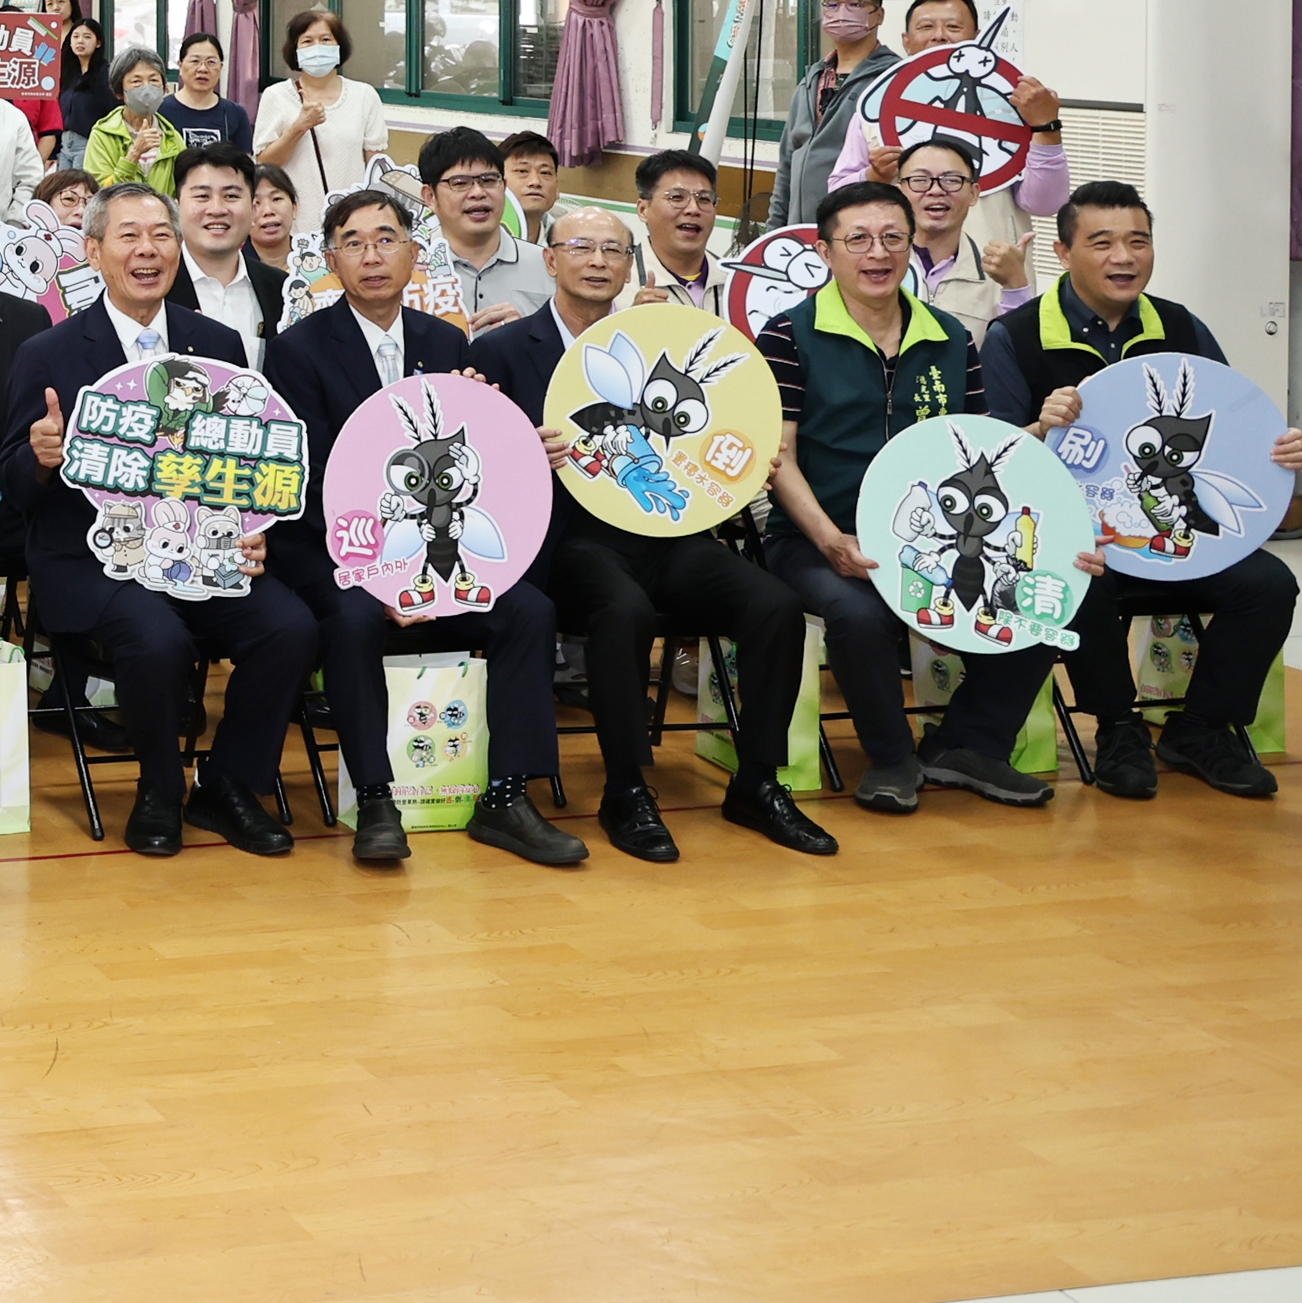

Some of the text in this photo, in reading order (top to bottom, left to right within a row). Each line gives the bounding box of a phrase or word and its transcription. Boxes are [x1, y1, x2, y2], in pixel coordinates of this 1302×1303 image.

[80, 395, 303, 462] 防疫 總動員
[1056, 427, 1106, 469] 刷
[67, 439, 302, 510] 清除 孳生源
[705, 432, 753, 477] 倒
[671, 450, 734, 508] 置積水容器
[335, 516, 377, 558] 巡
[338, 558, 409, 587] 居家戶內外
[1020, 574, 1066, 619] 清
[997, 609, 1075, 647] 除不要容器
